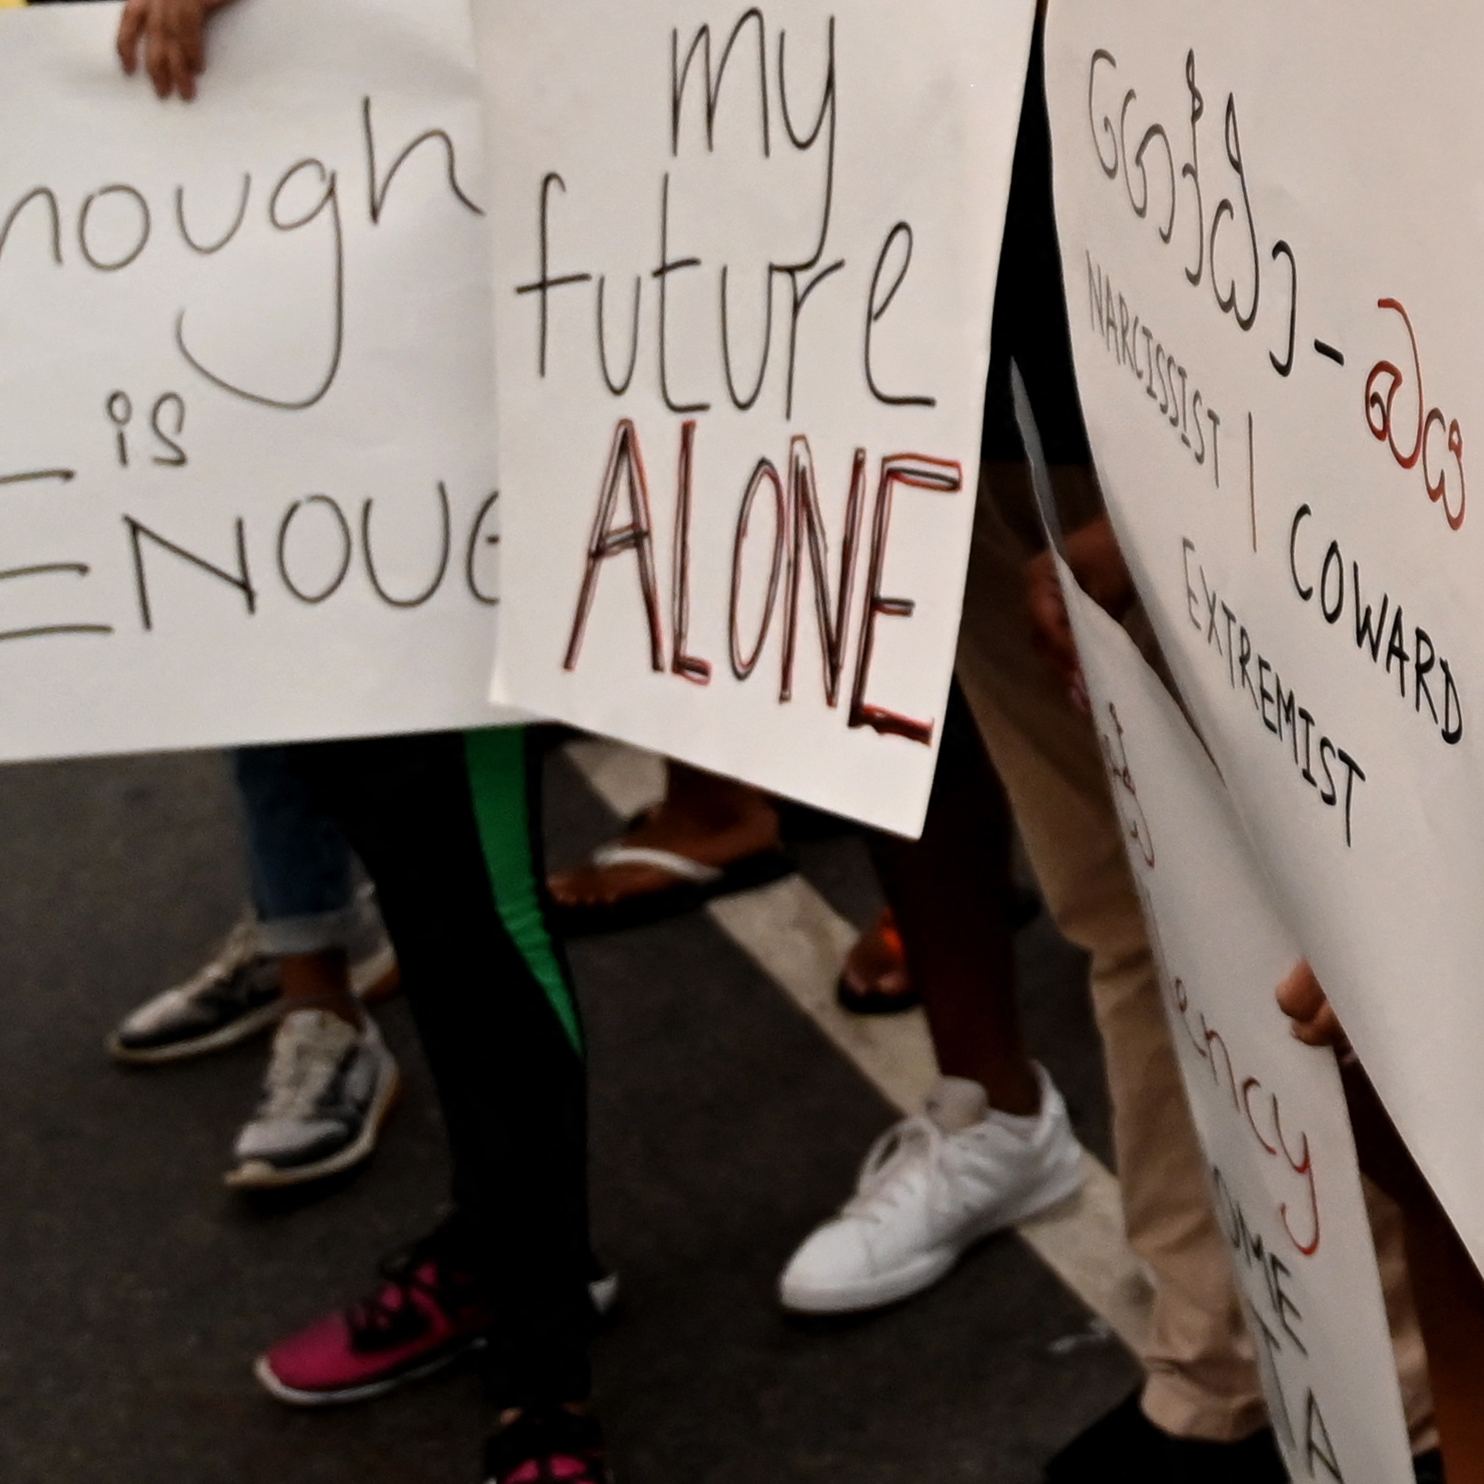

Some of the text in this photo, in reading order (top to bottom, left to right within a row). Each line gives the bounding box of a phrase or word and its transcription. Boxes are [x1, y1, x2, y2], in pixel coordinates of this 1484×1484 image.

[670, 6, 838, 272] my
[106, 389, 188, 467] is
[514, 171, 938, 420] future
[562, 417, 963, 746] ALONE
[1085, 248, 1222, 490] NARCISSIST
[1289, 503, 1464, 747] COWARD
[1181, 536, 1367, 849] EXTREMIST
